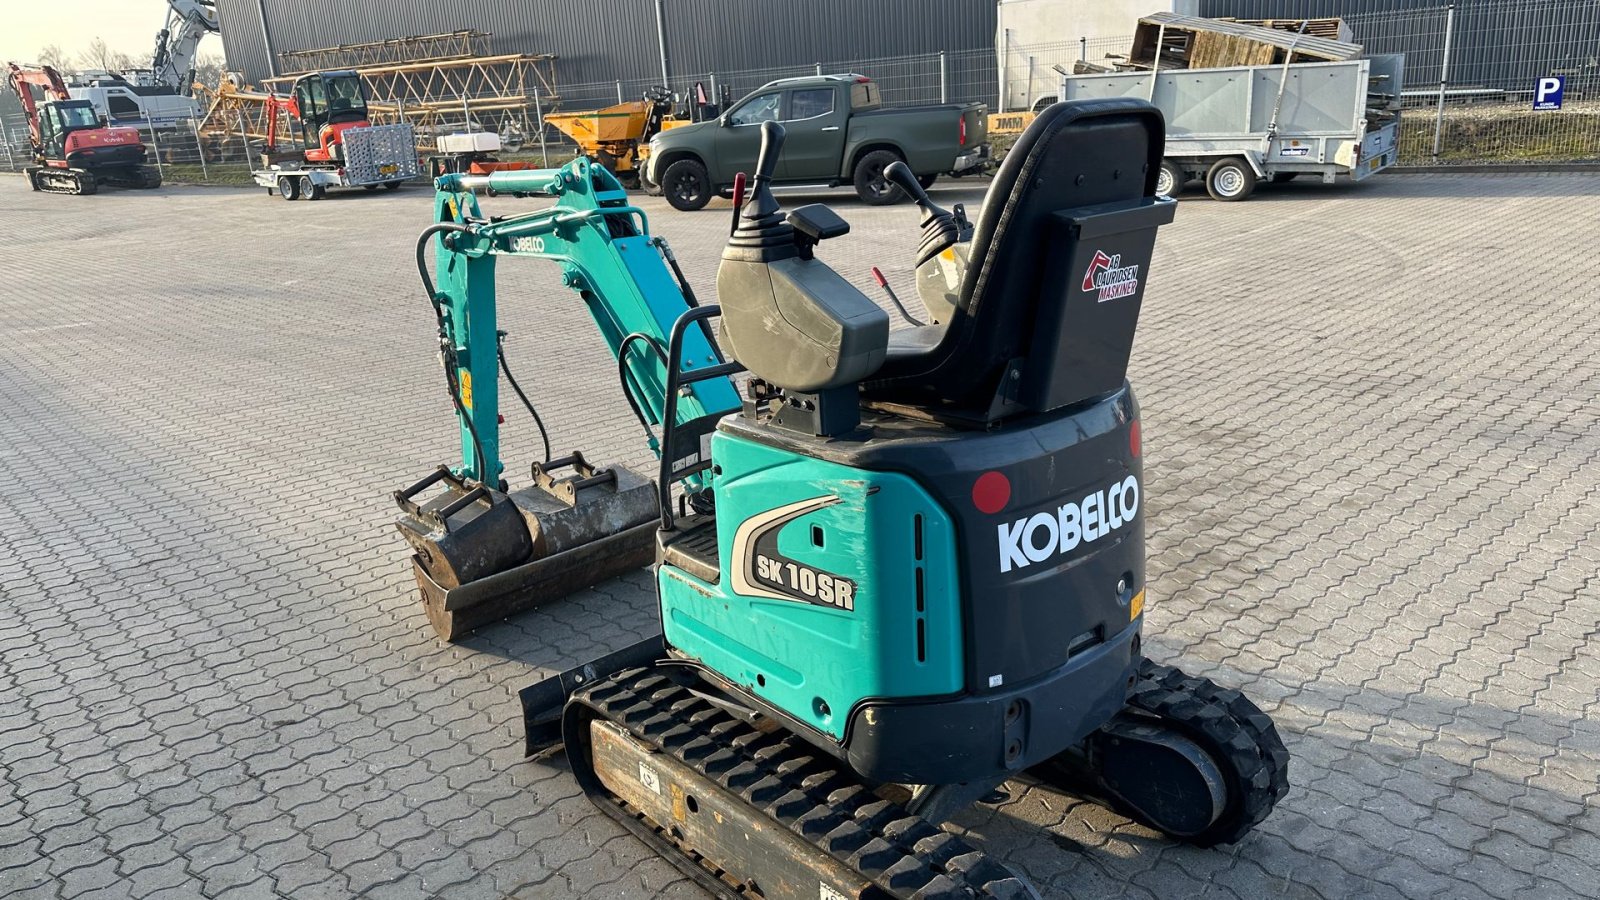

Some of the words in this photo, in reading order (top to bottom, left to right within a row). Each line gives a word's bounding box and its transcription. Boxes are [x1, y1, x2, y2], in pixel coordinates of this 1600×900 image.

[1537, 78, 1560, 102] P
[995, 117, 1023, 129] JMM
[508, 235, 545, 253] KOBELCO
[1109, 255, 1121, 270] AB
[1097, 265, 1138, 288] LAURIDSEN
[1098, 280, 1137, 301] MASKINER
[998, 475, 1139, 573] KOBELCO
